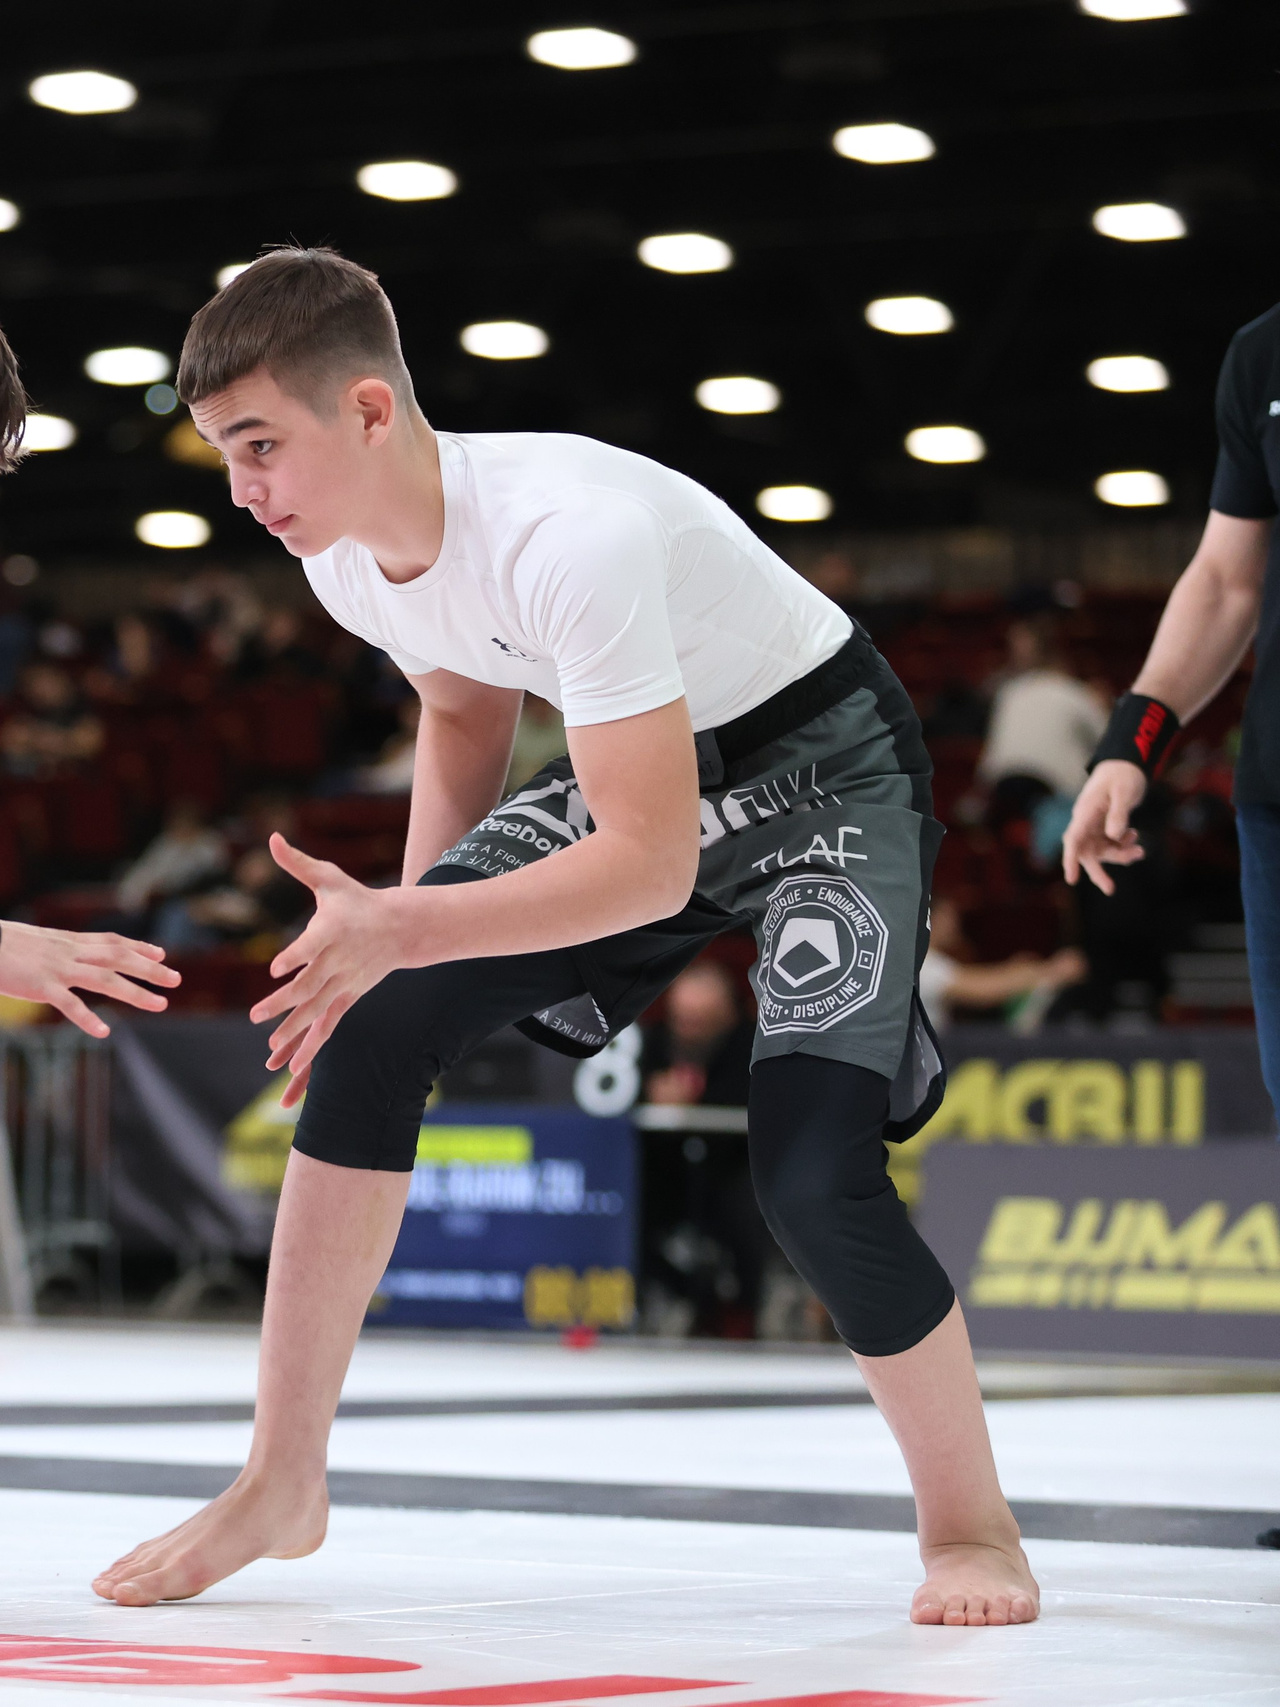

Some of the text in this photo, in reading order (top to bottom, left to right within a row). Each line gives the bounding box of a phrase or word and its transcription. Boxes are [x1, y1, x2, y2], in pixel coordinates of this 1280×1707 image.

[481, 844, 491, 855] A
[494, 848, 529, 868] FIGH
[817, 886, 874, 938] ENDURANCE
[792, 976, 863, 1019] DISCIPLINE
